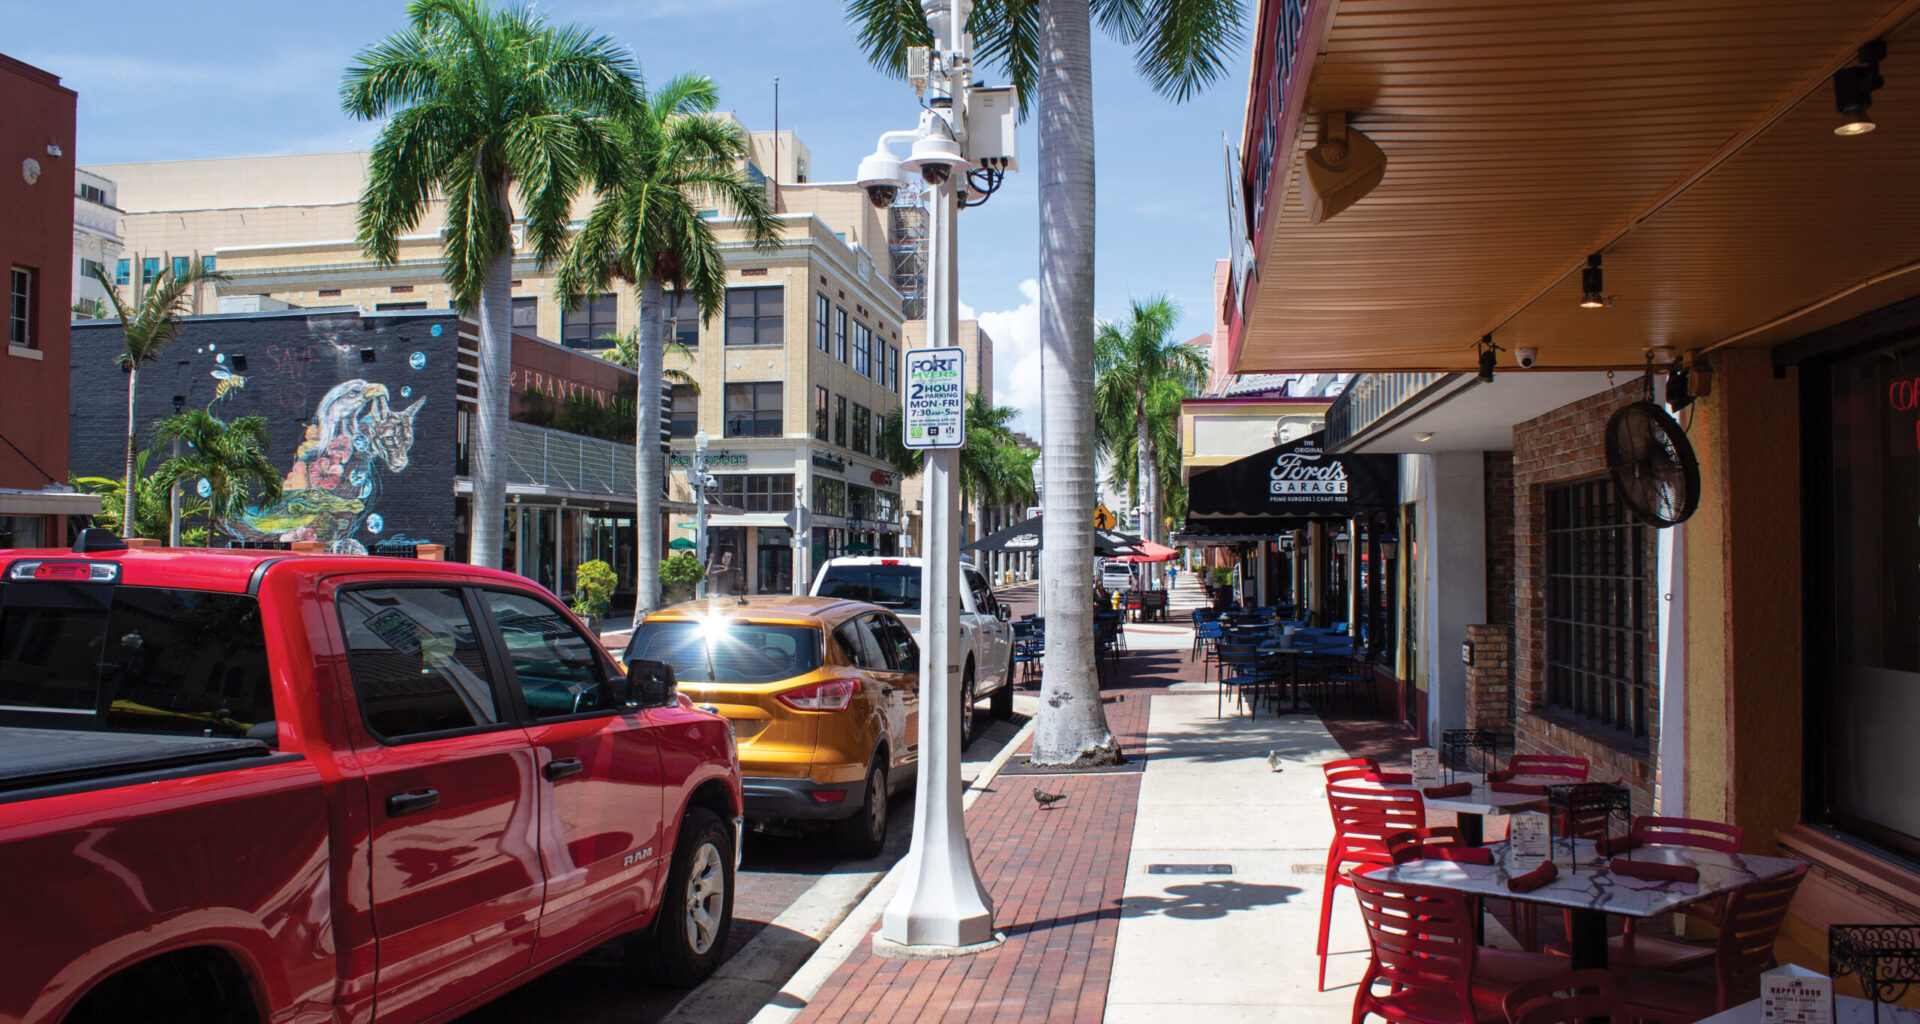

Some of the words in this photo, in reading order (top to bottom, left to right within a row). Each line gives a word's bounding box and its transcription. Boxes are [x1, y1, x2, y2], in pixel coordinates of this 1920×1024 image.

[262, 344, 322, 380] SAVE
[911, 358, 958, 373] FORT
[911, 370, 958, 379] MYERS
[278, 382, 307, 409] US
[523, 369, 606, 409] FRANKLIN
[611, 394, 637, 418] SHO
[911, 383, 924, 400] 2
[925, 384, 958, 393] HOUR
[1270, 453, 1348, 480] Ford's
[1272, 482, 1346, 492] GARAGE
[623, 846, 653, 867] RAM
[1770, 987, 1796, 995] HAPPY
[1799, 988, 1821, 997] HOUR
